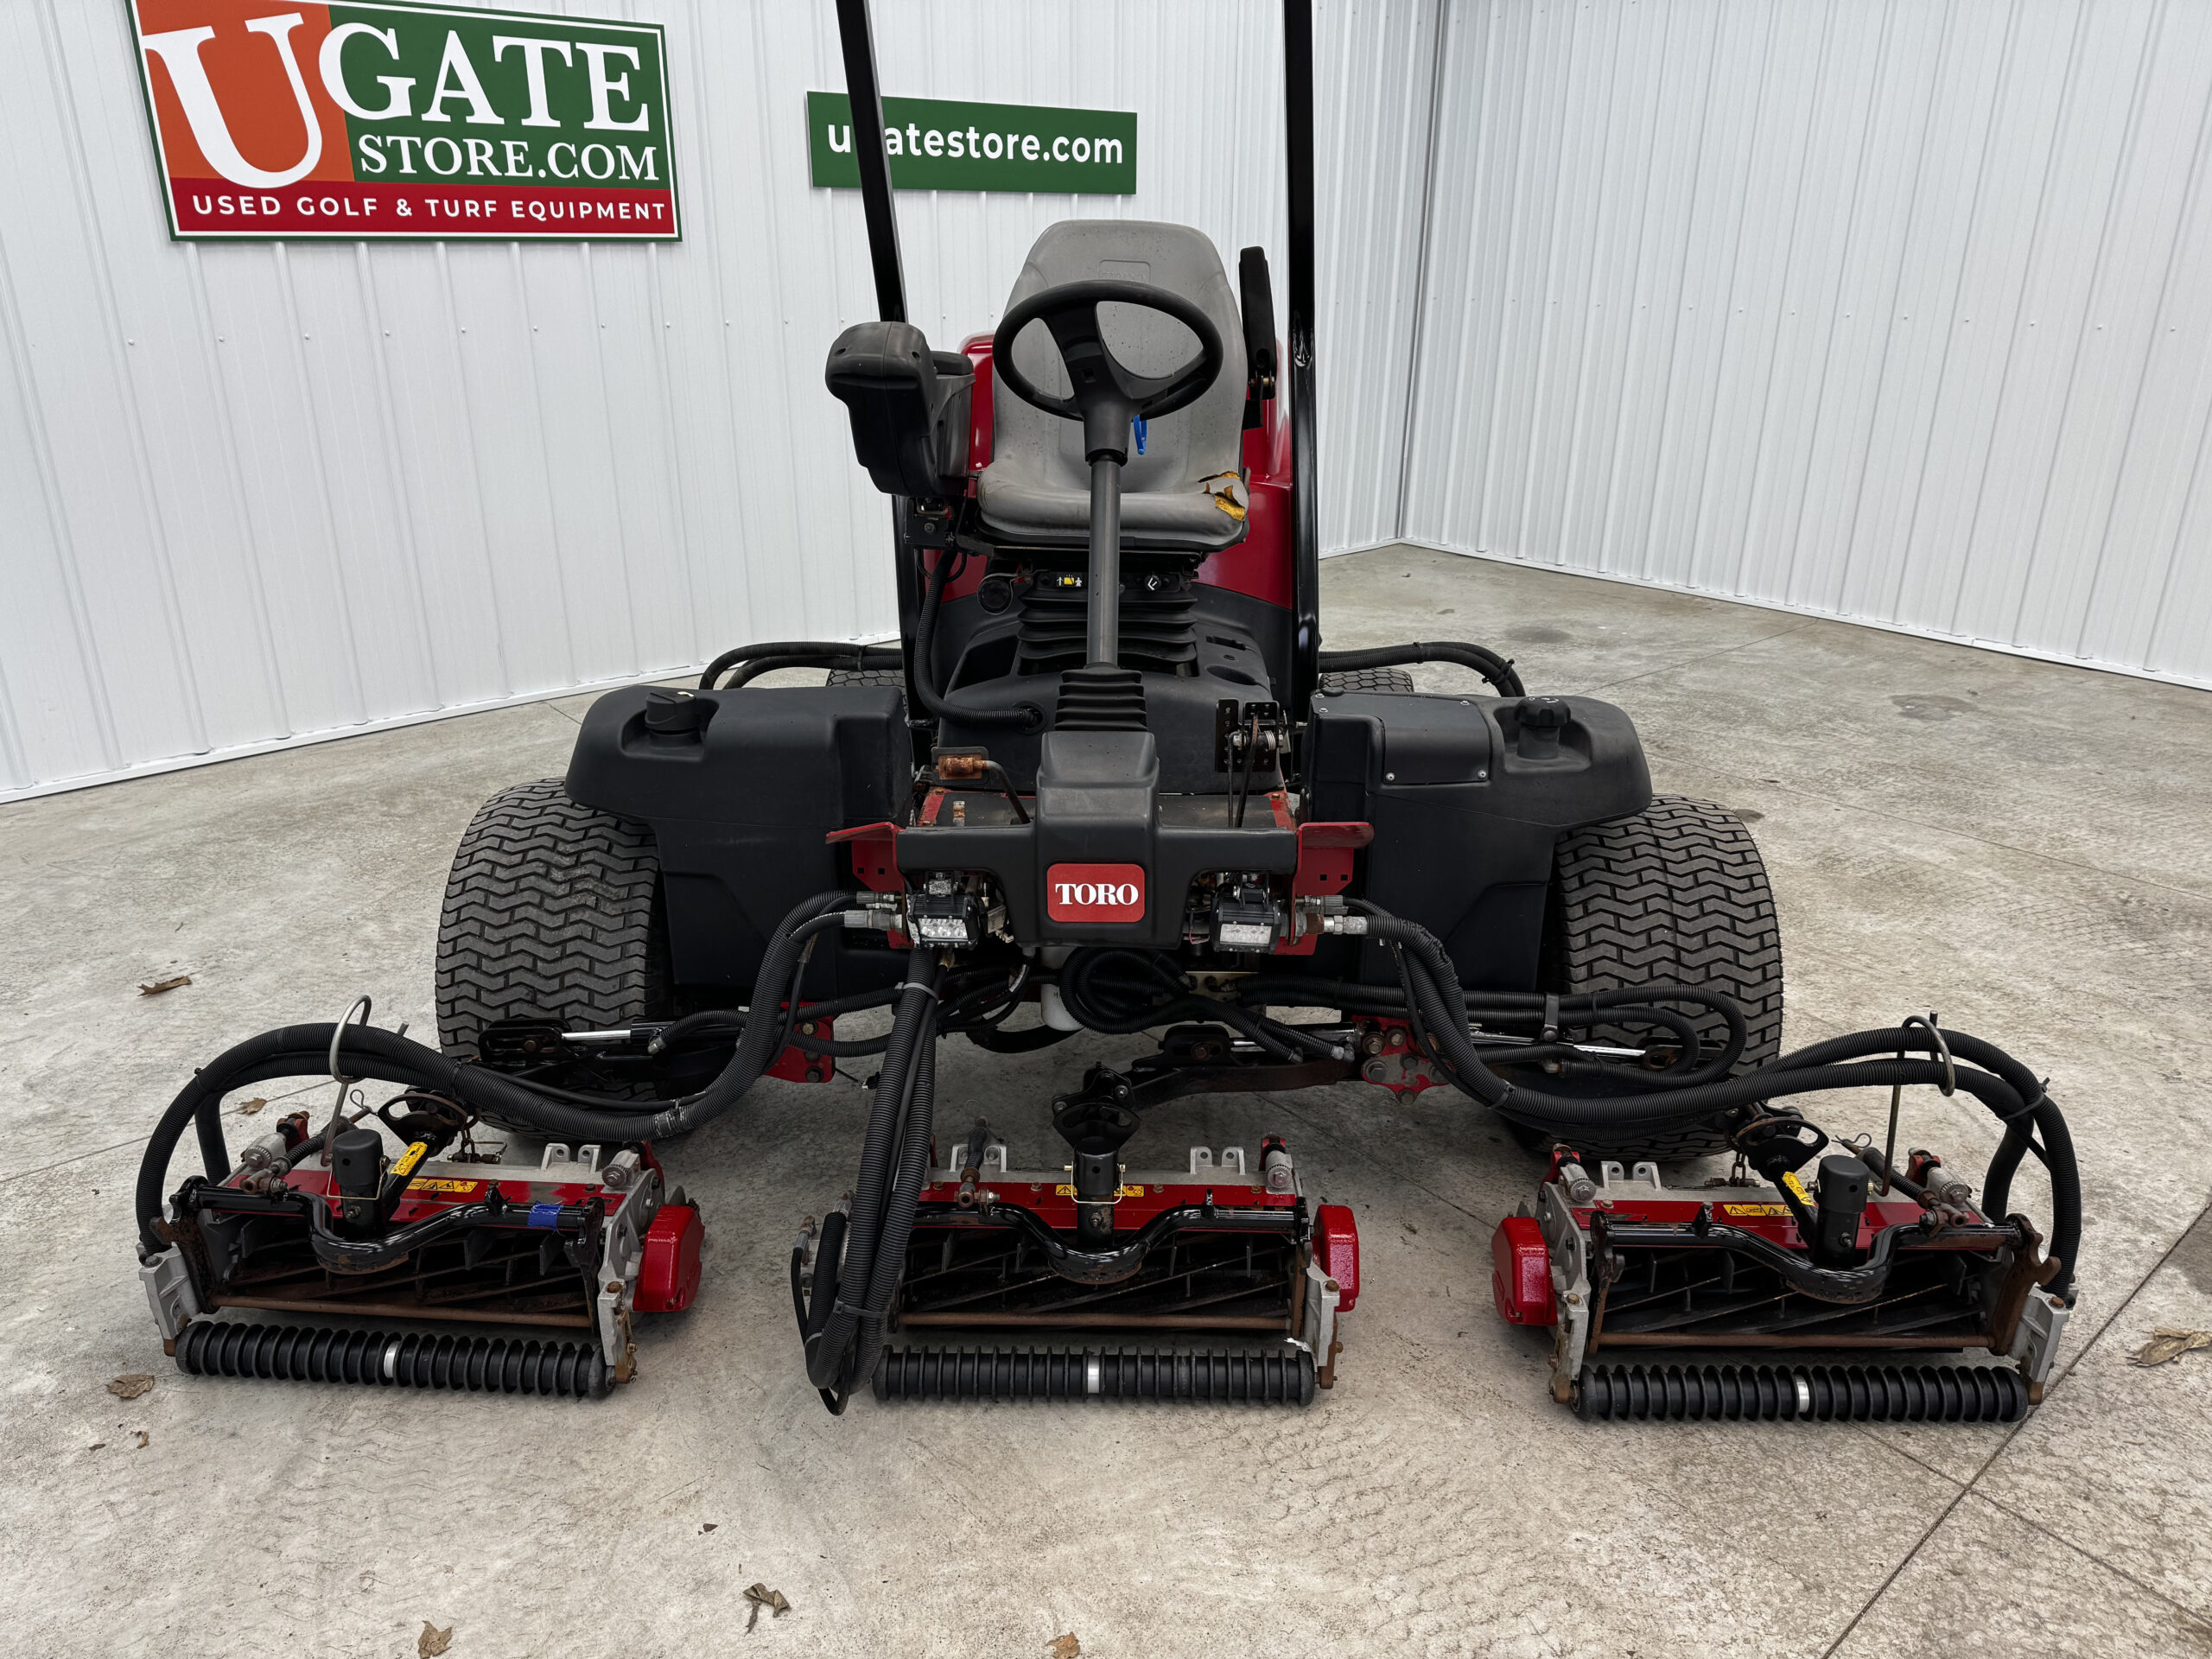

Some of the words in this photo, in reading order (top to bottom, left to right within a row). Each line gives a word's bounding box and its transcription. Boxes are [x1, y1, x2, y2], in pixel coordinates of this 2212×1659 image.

[359, 134, 659, 181] STORE.COM
[828, 123, 1122, 164] uatestore.com
[193, 194, 281, 215] USED
[296, 196, 378, 217] GOLF
[396, 198, 413, 217] &
[424, 199, 498, 218] TURF
[511, 200, 665, 222] EQUIPMENT
[1055, 883, 1139, 906] TORO
